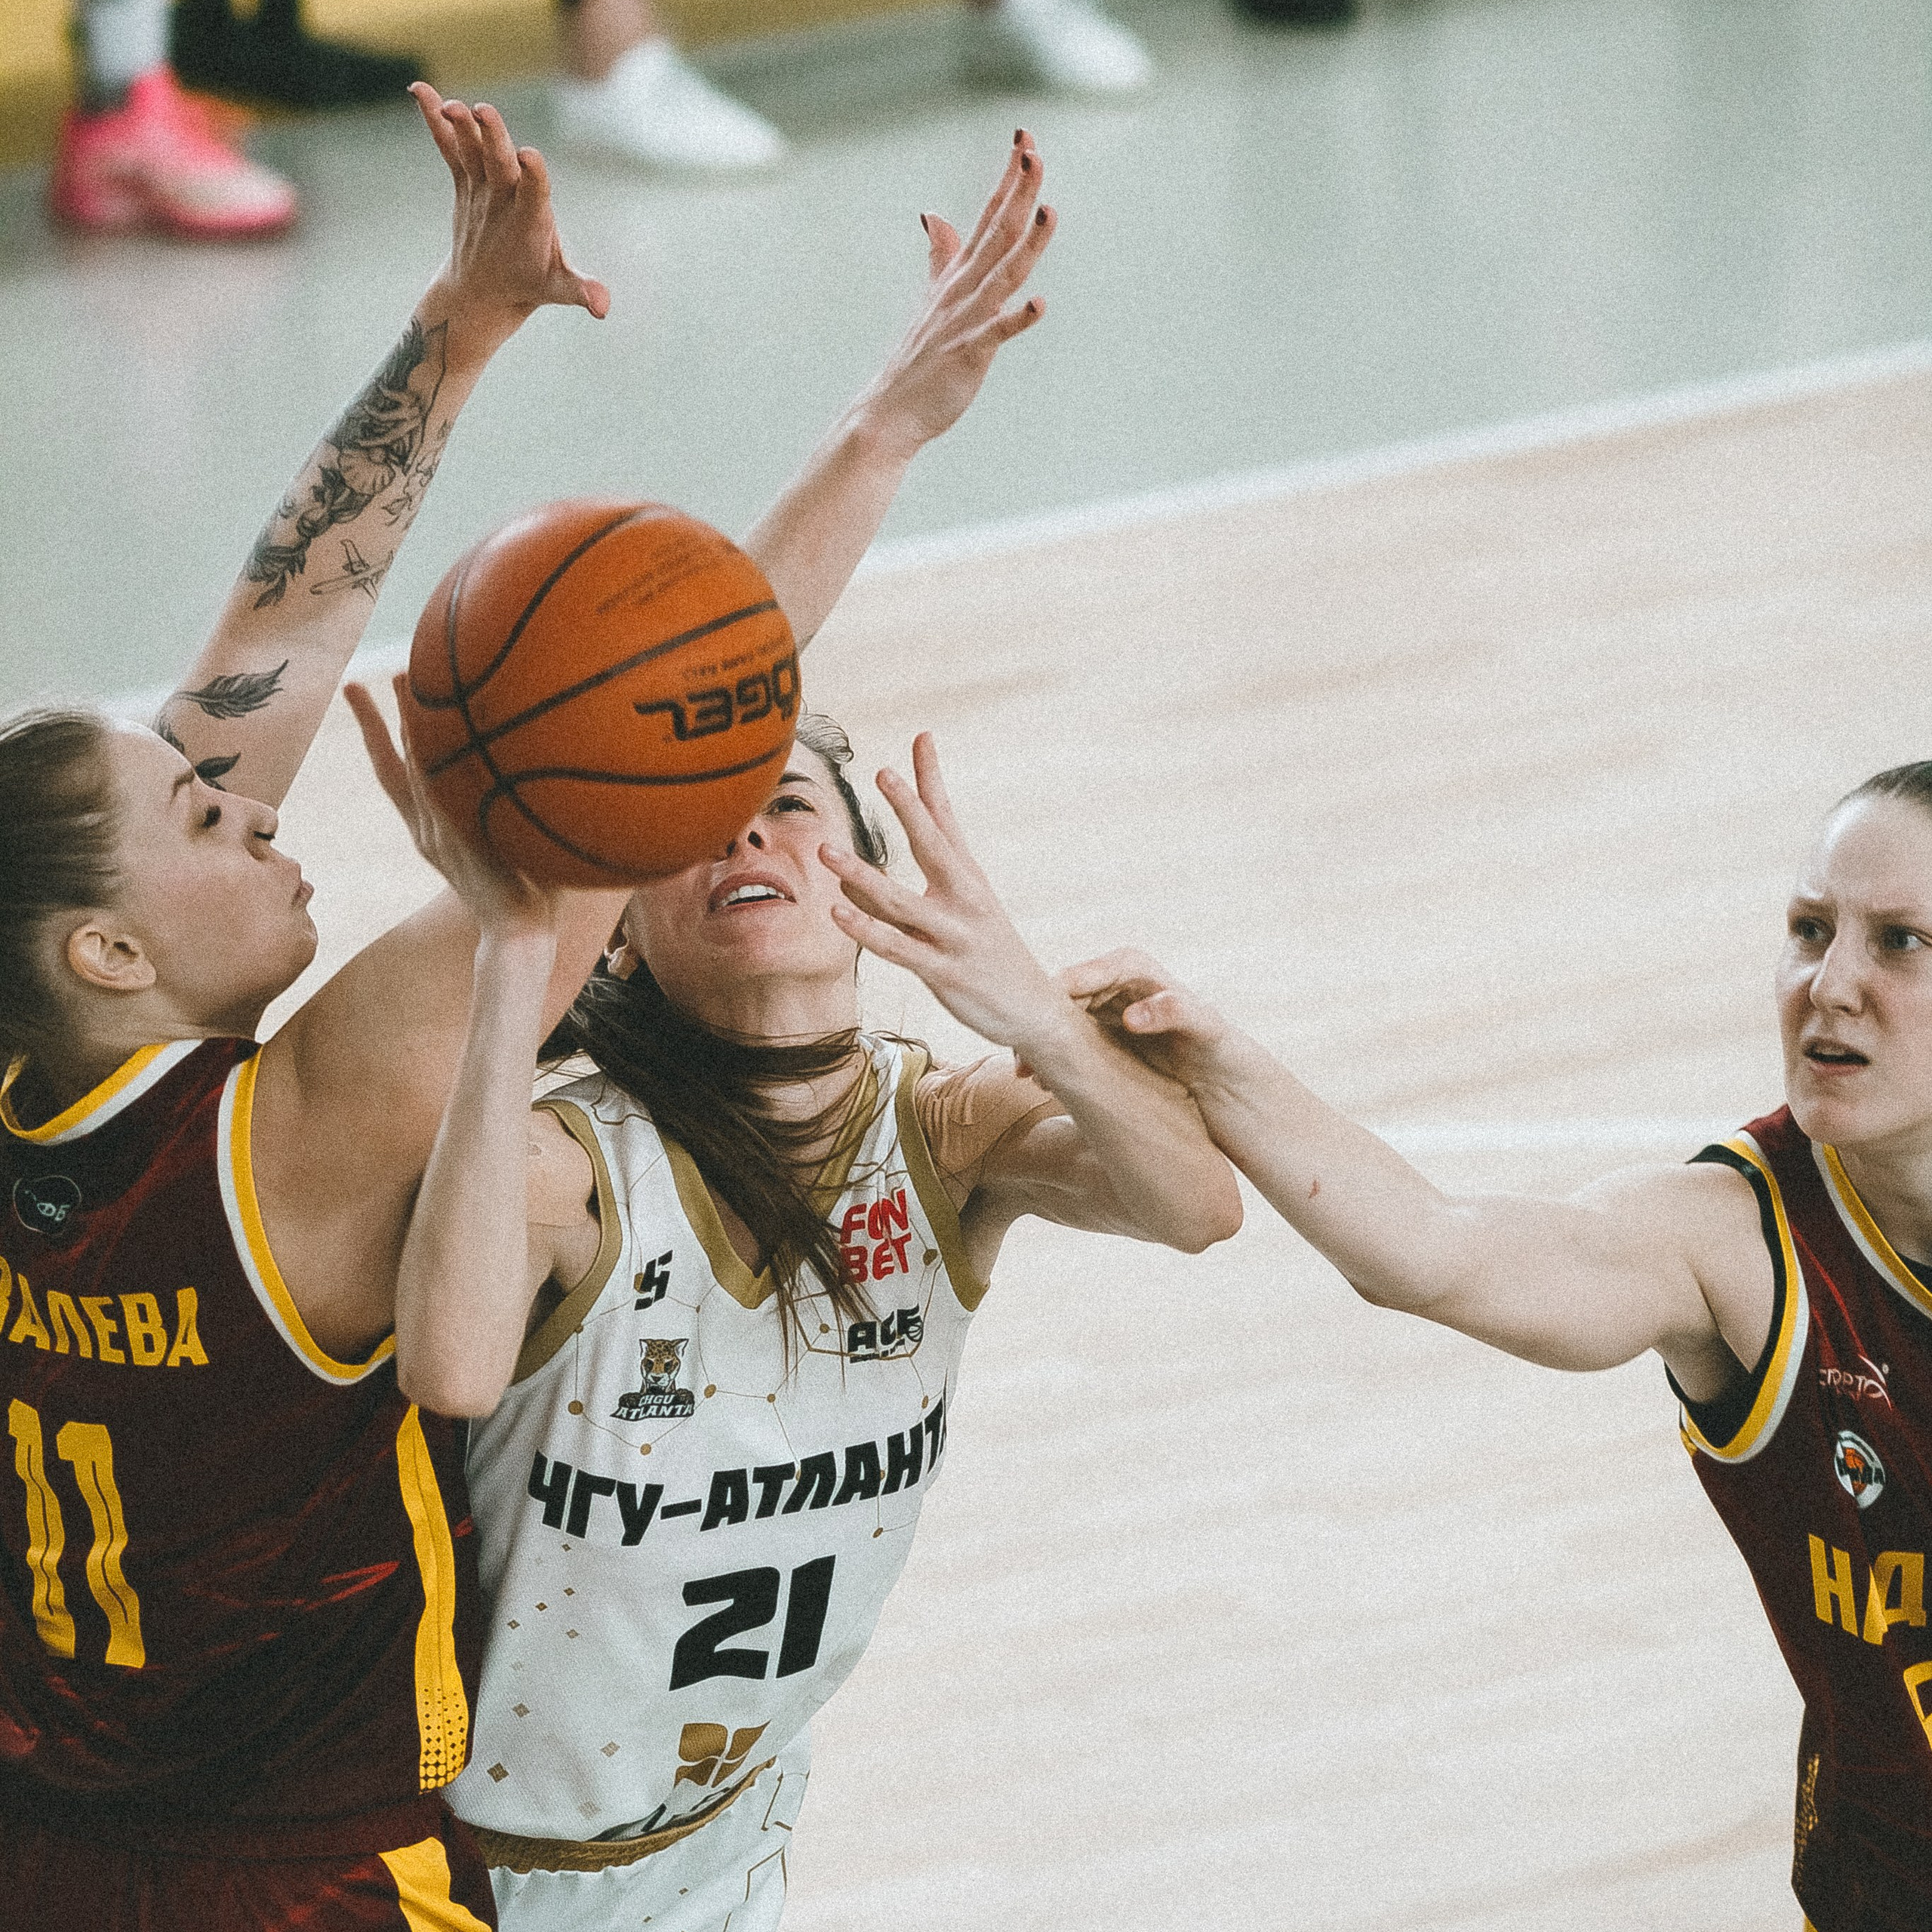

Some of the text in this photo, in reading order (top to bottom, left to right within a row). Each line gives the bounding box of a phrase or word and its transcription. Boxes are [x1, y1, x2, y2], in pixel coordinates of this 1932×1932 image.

[840, 1189, 909, 1244] FON
[839, 1232, 912, 1283] BET
[616, 1404, 694, 1420] ATLANTA
[638, 1394, 675, 1407] CHGU
[528, 1398, 946, 1546] ЧГУ-АТЛАНТ
[8, 1398, 146, 1669] 11
[669, 1555, 835, 1691] 21
